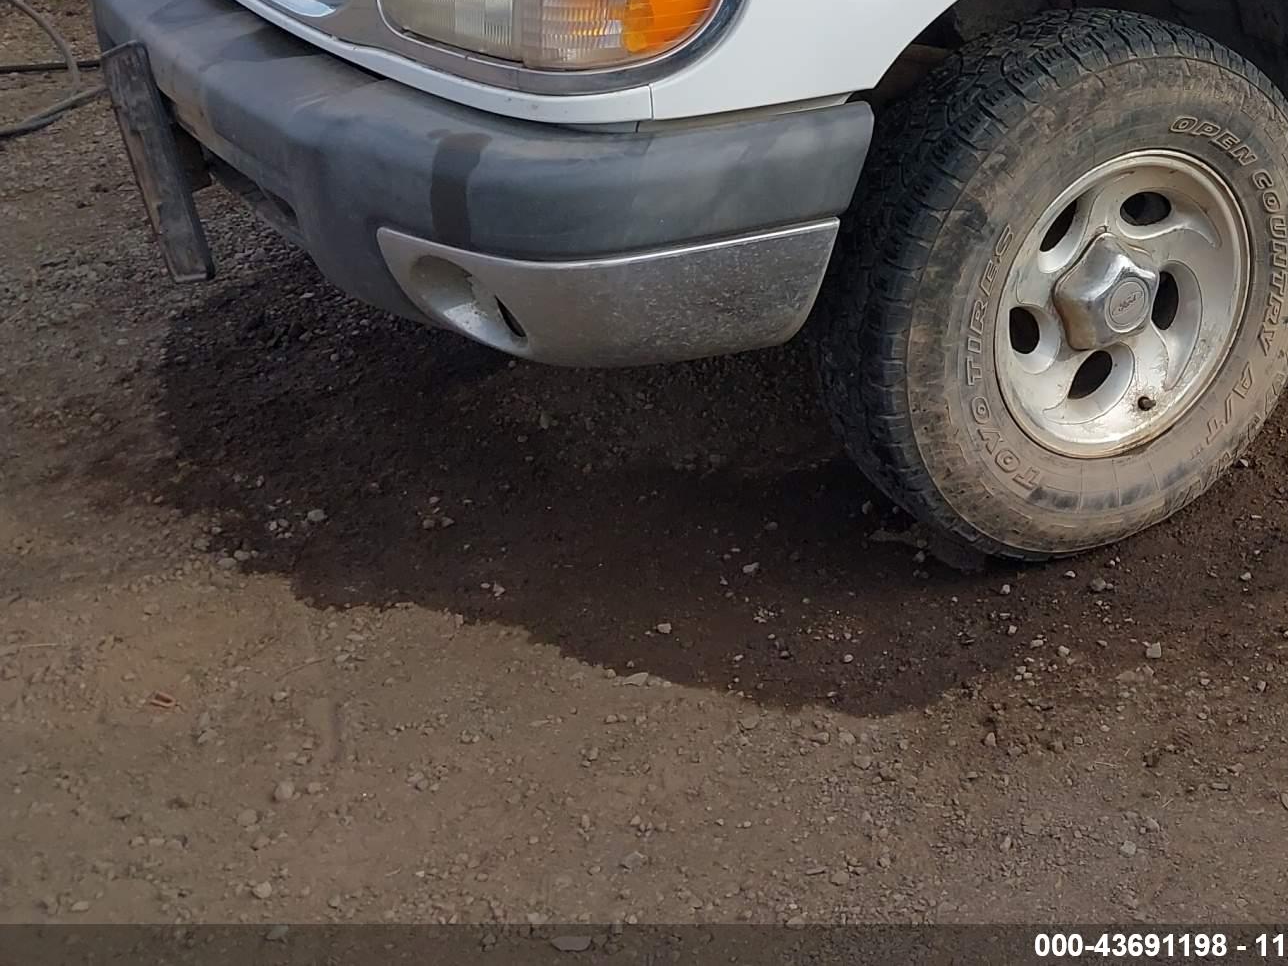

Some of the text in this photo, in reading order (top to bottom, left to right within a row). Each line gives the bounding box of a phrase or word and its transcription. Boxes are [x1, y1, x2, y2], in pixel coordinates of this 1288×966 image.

[966, 224, 1041, 490] TOYO TIRES
[1170, 116, 1258, 166] OPEN
[1252, 169, 1288, 357] COUNTRY
